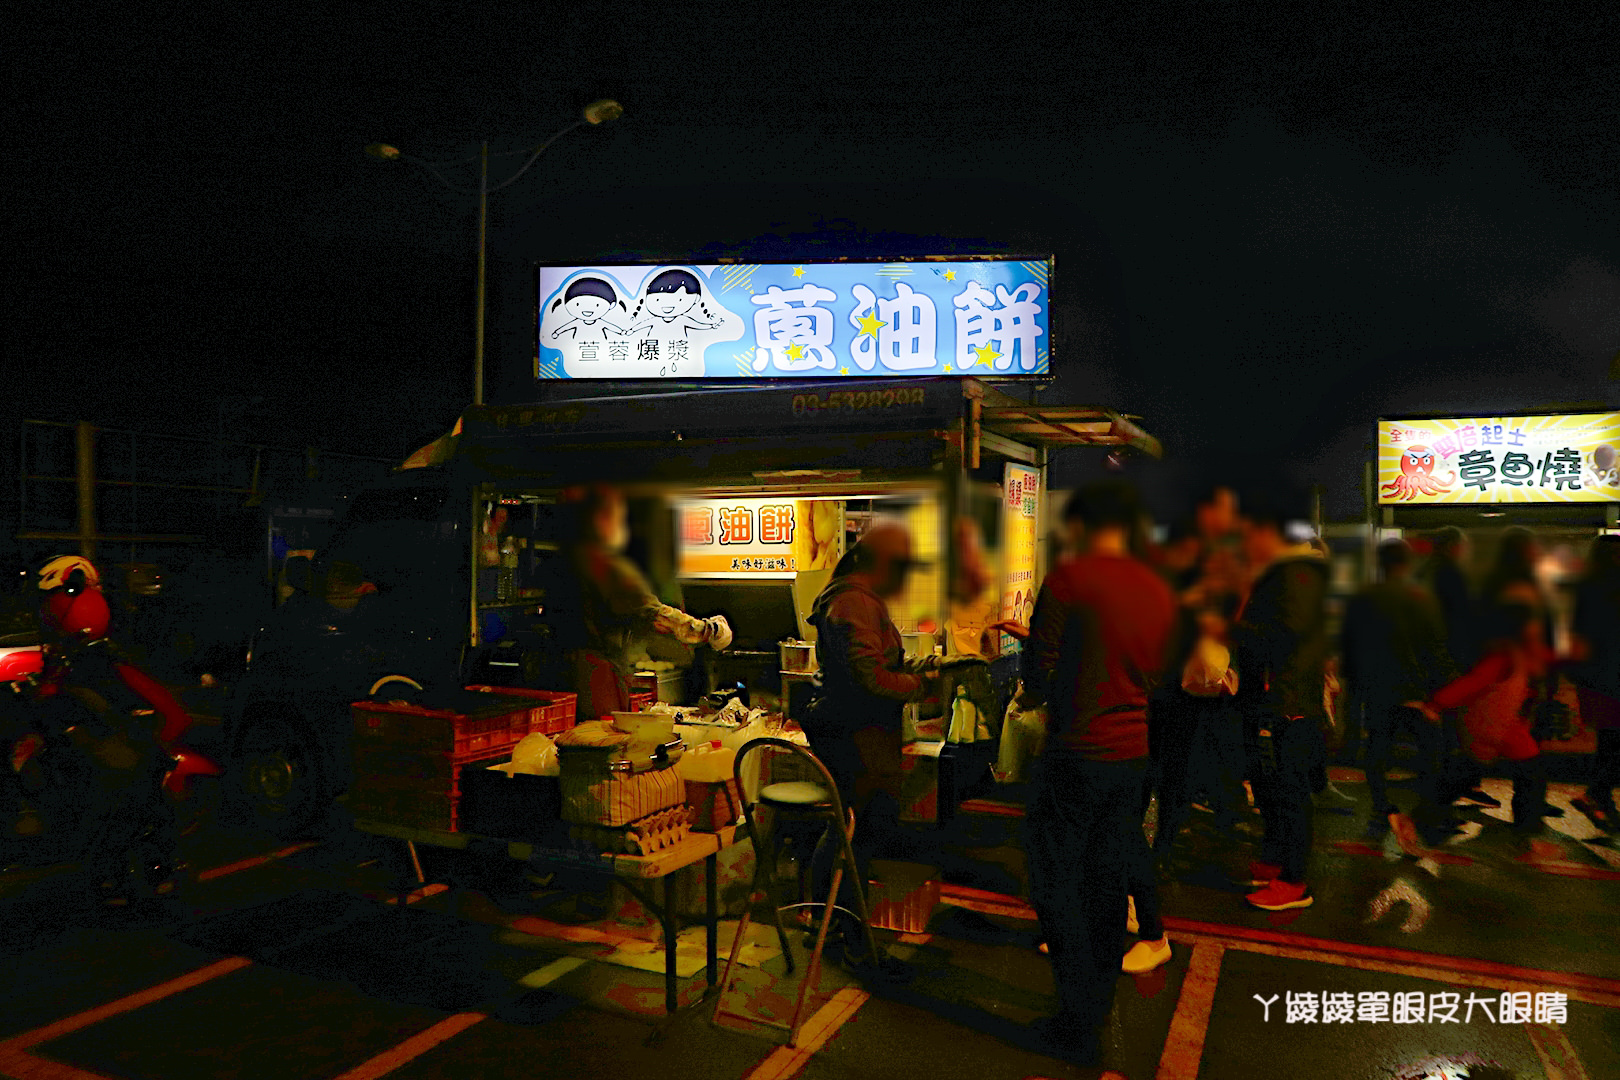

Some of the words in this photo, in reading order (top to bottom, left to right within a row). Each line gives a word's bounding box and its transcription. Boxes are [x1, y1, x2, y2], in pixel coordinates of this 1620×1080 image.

[750, 282, 1044, 373] 蔥油餅
[578, 339, 690, 362] 萱蓉爆漿
[1458, 447, 1582, 491] 章魚燒
